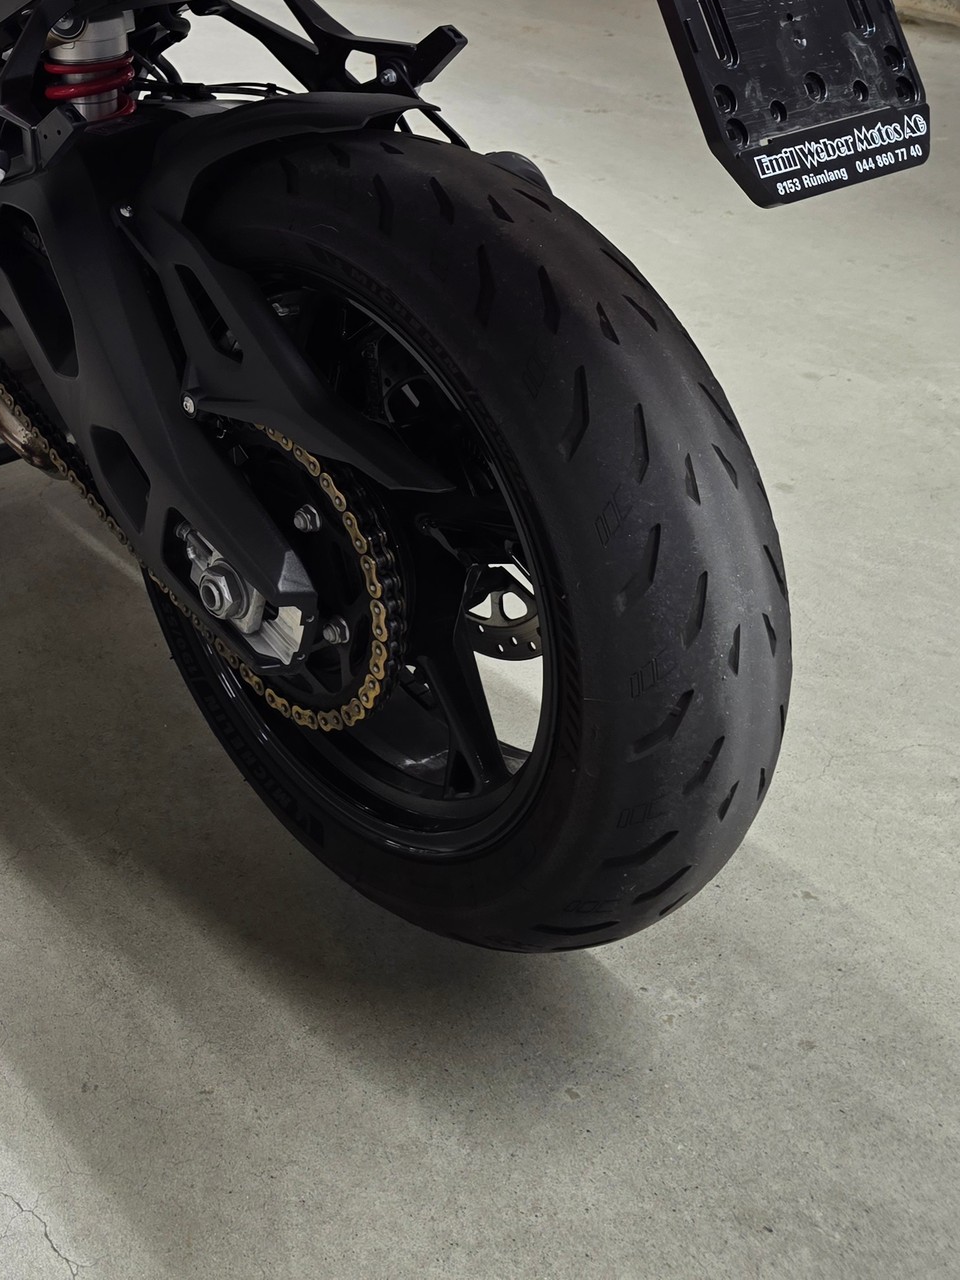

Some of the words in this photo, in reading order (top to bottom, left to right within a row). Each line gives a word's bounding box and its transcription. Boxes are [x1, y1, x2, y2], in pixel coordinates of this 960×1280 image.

[754, 148, 800, 179] Emil
[796, 134, 854, 169] Weber
[853, 122, 904, 152] Motos
[903, 113, 928, 140] AG
[776, 177, 801, 196] 8153
[803, 167, 849, 189] Rümlang
[855, 157, 875, 174] 044
[875, 151, 895, 168] 860
[897, 148, 908, 162] 77
[909, 144, 923, 157] 40
[349, 266, 460, 374] MICHELIN
[202, 694, 293, 809] MICHELIN
